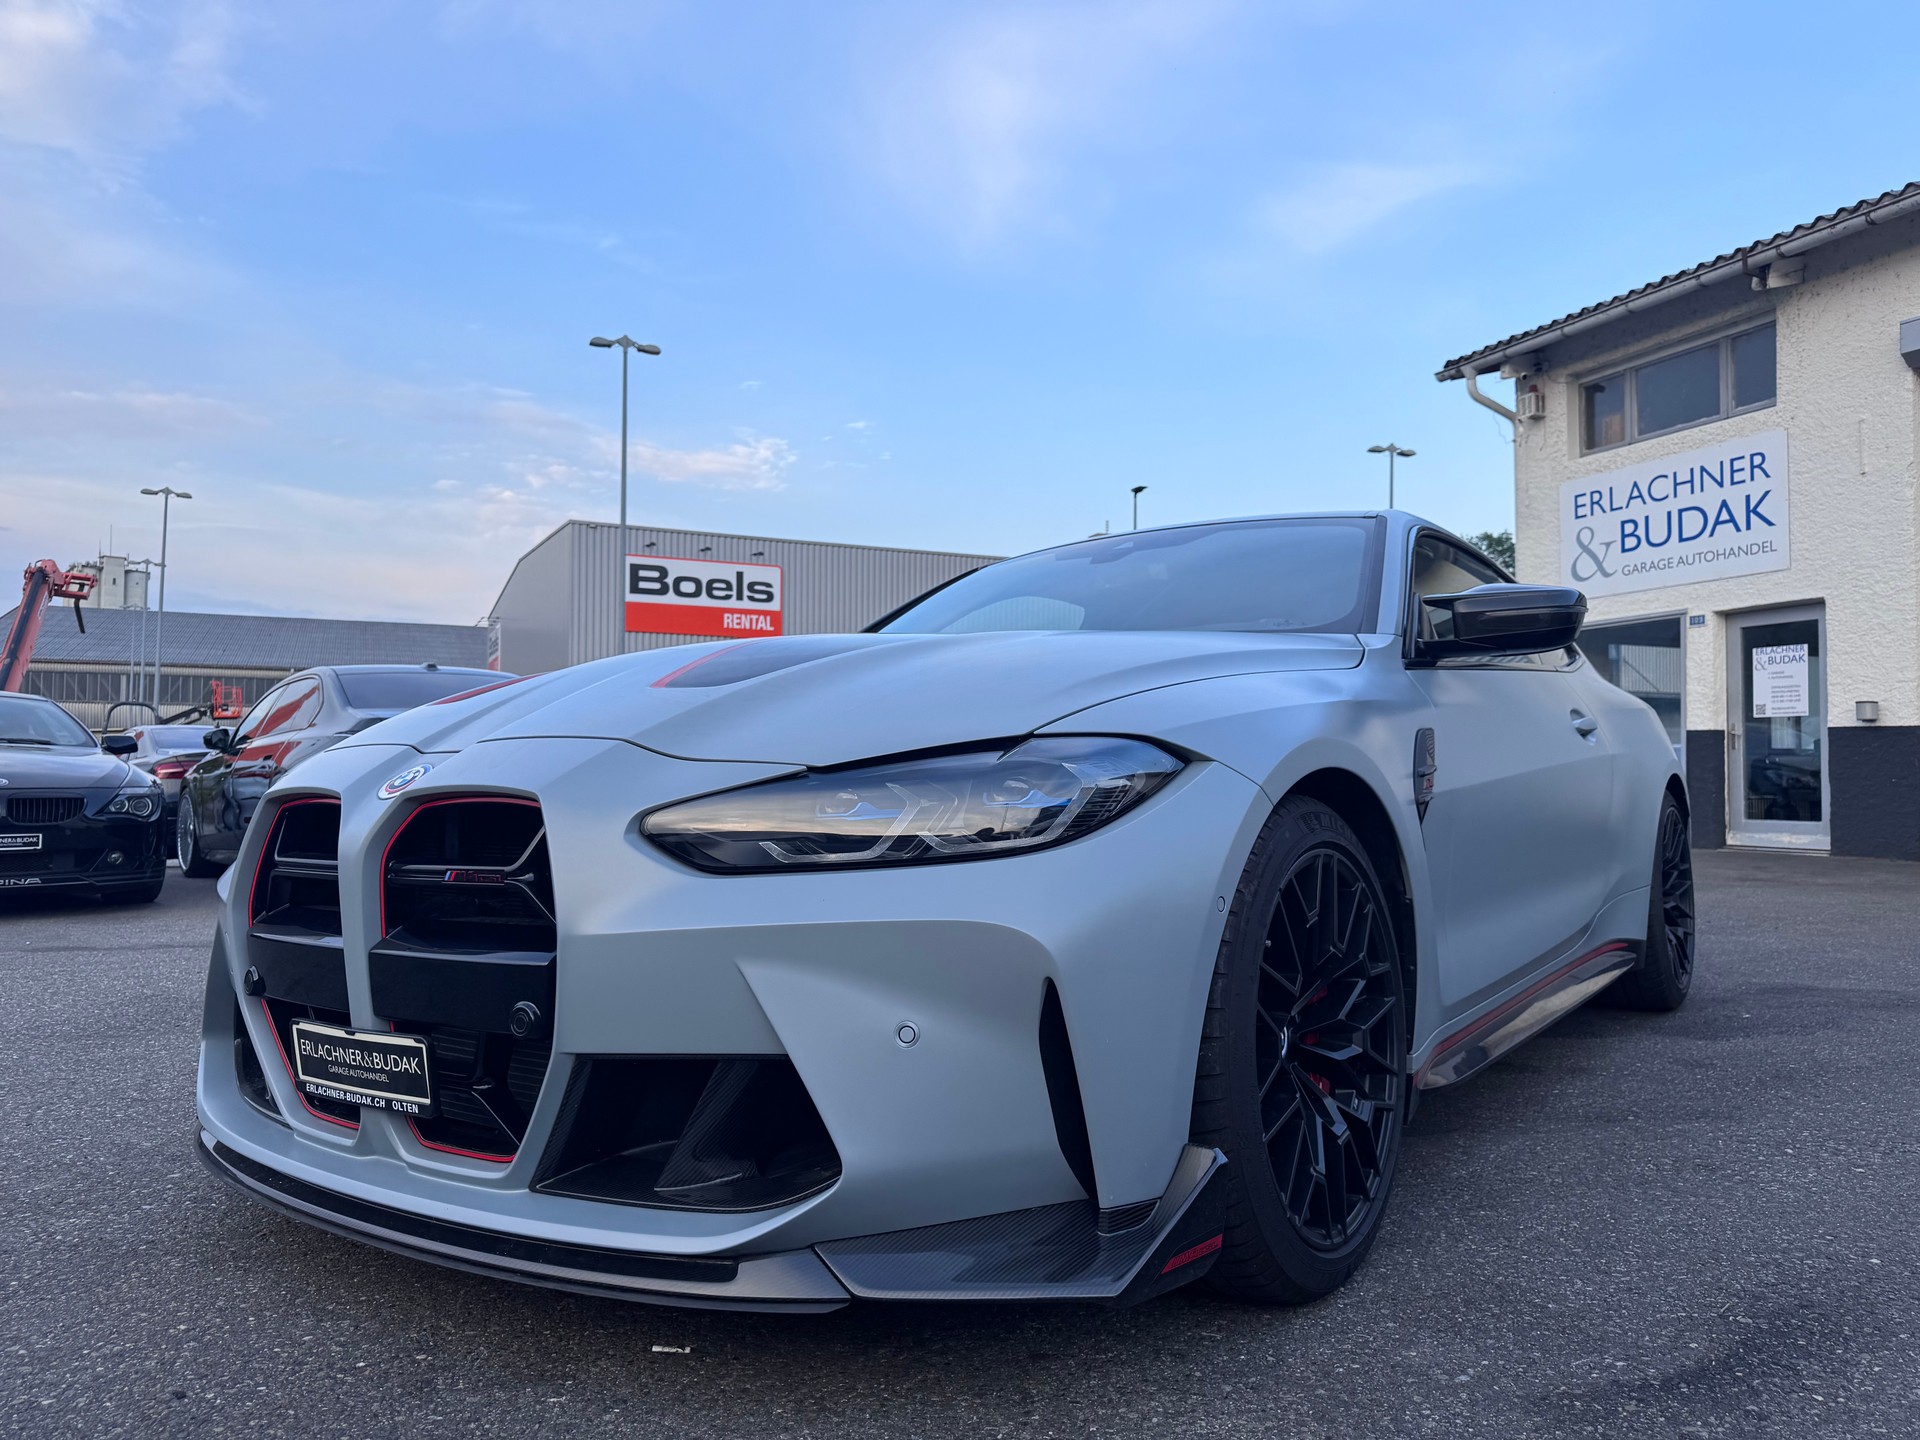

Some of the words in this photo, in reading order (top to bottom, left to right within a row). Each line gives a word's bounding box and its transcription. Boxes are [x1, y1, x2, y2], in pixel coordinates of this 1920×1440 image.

[1574, 452, 1771, 520] ERLACHNER
[1570, 526, 1617, 582] &
[1620, 489, 1776, 553] BUDAK
[1621, 557, 1674, 577] GARAGE
[1676, 540, 1777, 568] AUTOHANDEL
[629, 563, 774, 603] Boels
[723, 613, 774, 631] RENTAL
[1755, 645, 1805, 656] ERLACHNER
[1768, 654, 1805, 665] BUDAK
[328, 1064, 349, 1076] GARAGE
[349, 1068, 389, 1082] AUTOHANDEL
[306, 1083, 385, 1108] ERLACHNER-BUDAK.CH
[392, 1101, 418, 1113] OLTEN
